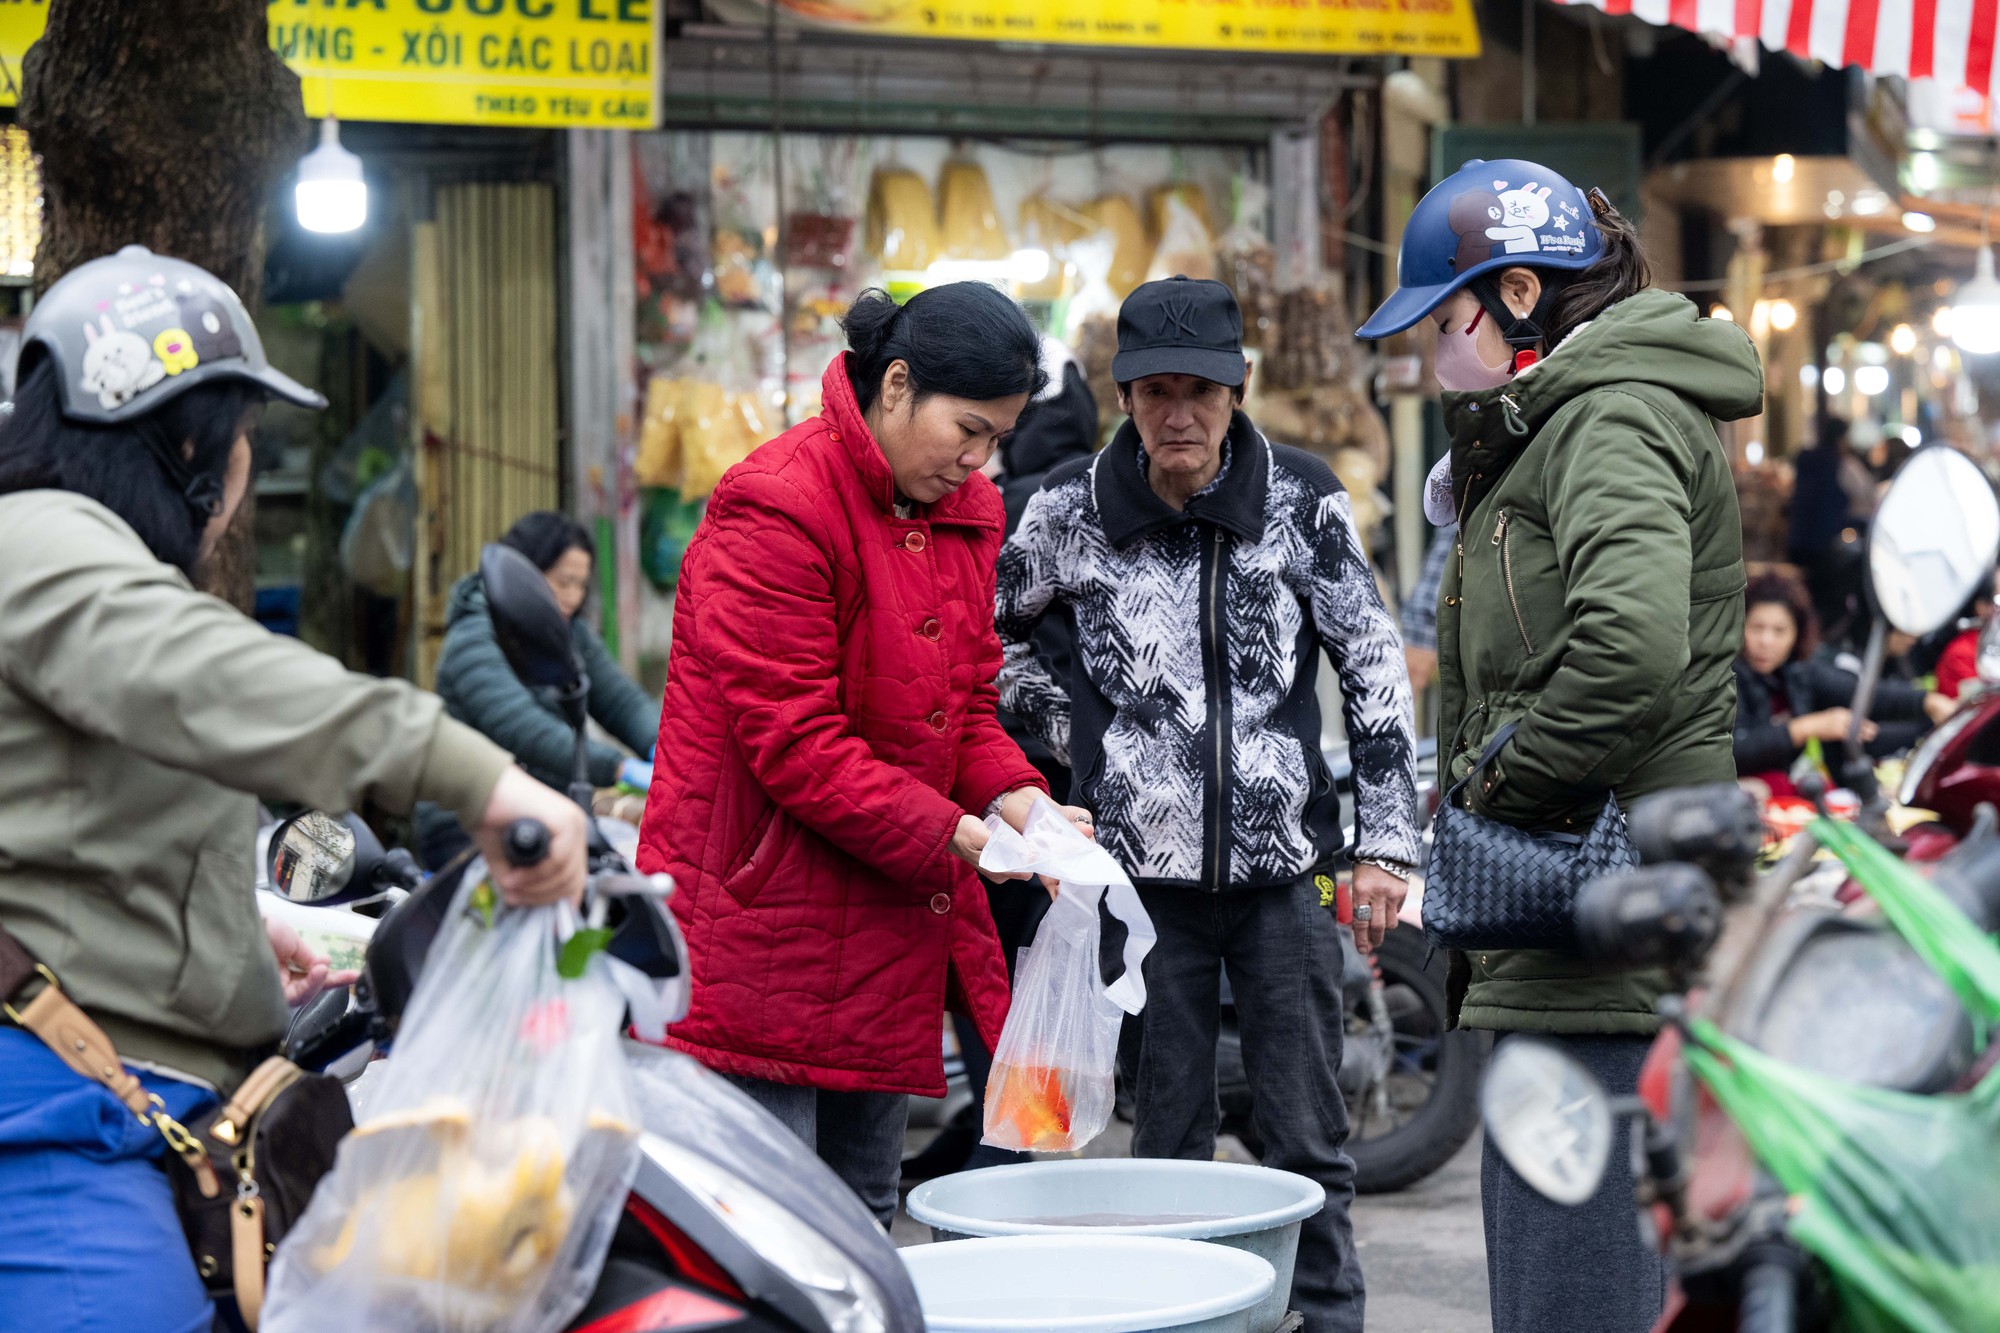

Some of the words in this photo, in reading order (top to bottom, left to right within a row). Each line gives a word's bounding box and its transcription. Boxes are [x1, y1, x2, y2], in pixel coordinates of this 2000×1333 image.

[402, 23, 462, 66] XÔI
[478, 27, 552, 71] CÁC
[568, 38, 648, 83] LOẠI
[476, 94, 536, 115] THEO
